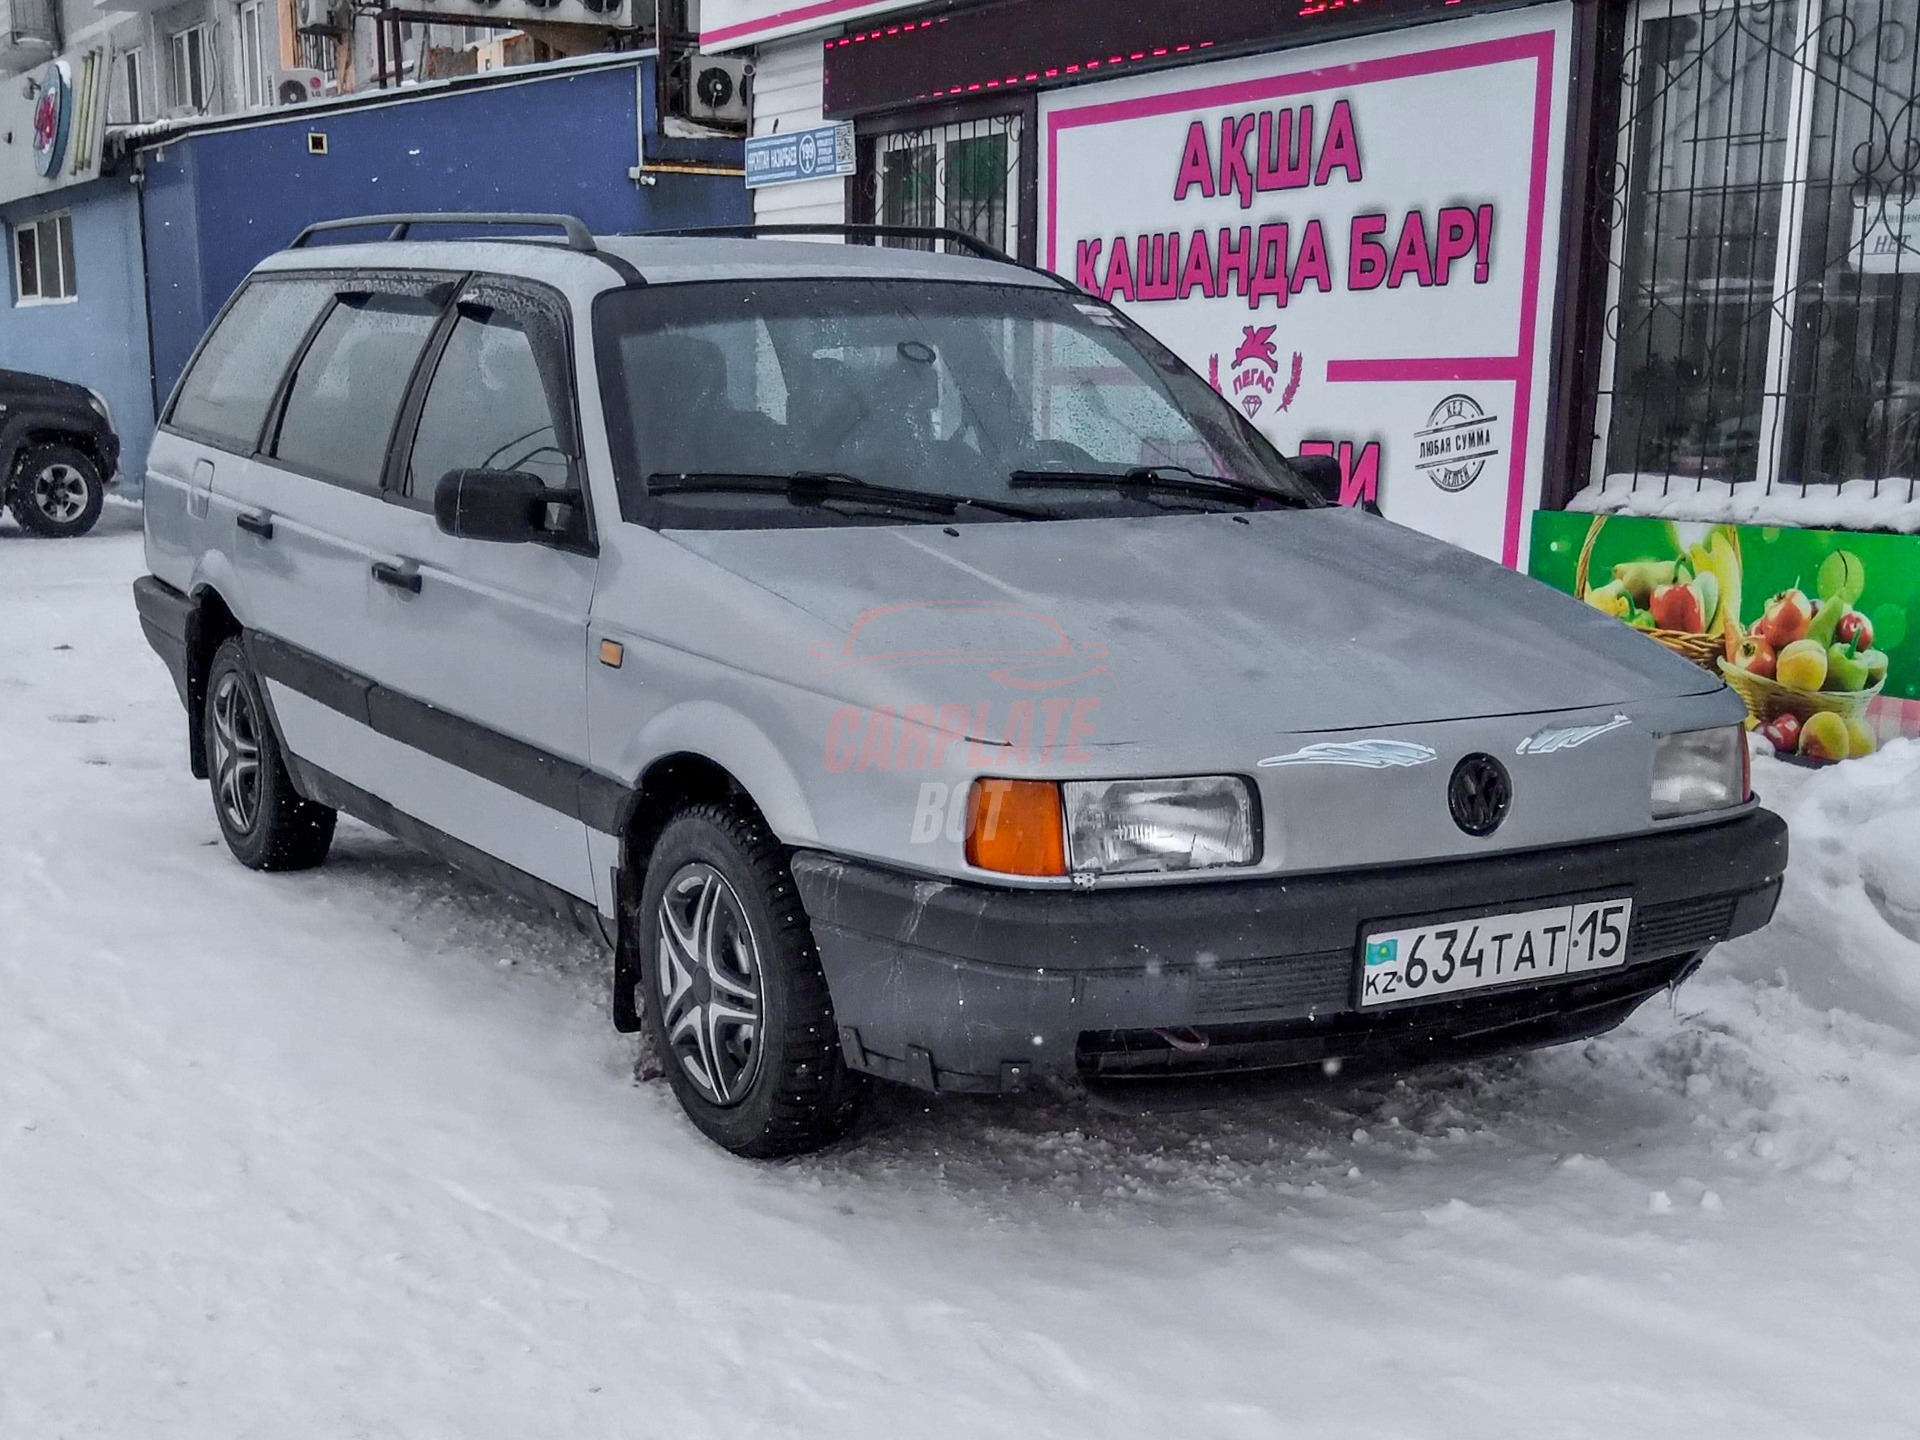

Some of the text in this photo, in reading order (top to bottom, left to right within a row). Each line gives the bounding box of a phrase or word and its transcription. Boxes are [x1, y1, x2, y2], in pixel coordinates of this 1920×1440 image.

[1174, 99, 1362, 208] АҚША
[1347, 204, 1493, 291] БАР!
[1233, 368, 1274, 395] ПЕГАС
[1419, 429, 1490, 458] ЛЮБАЯ СУММА
[1365, 971, 1397, 996] KZ
